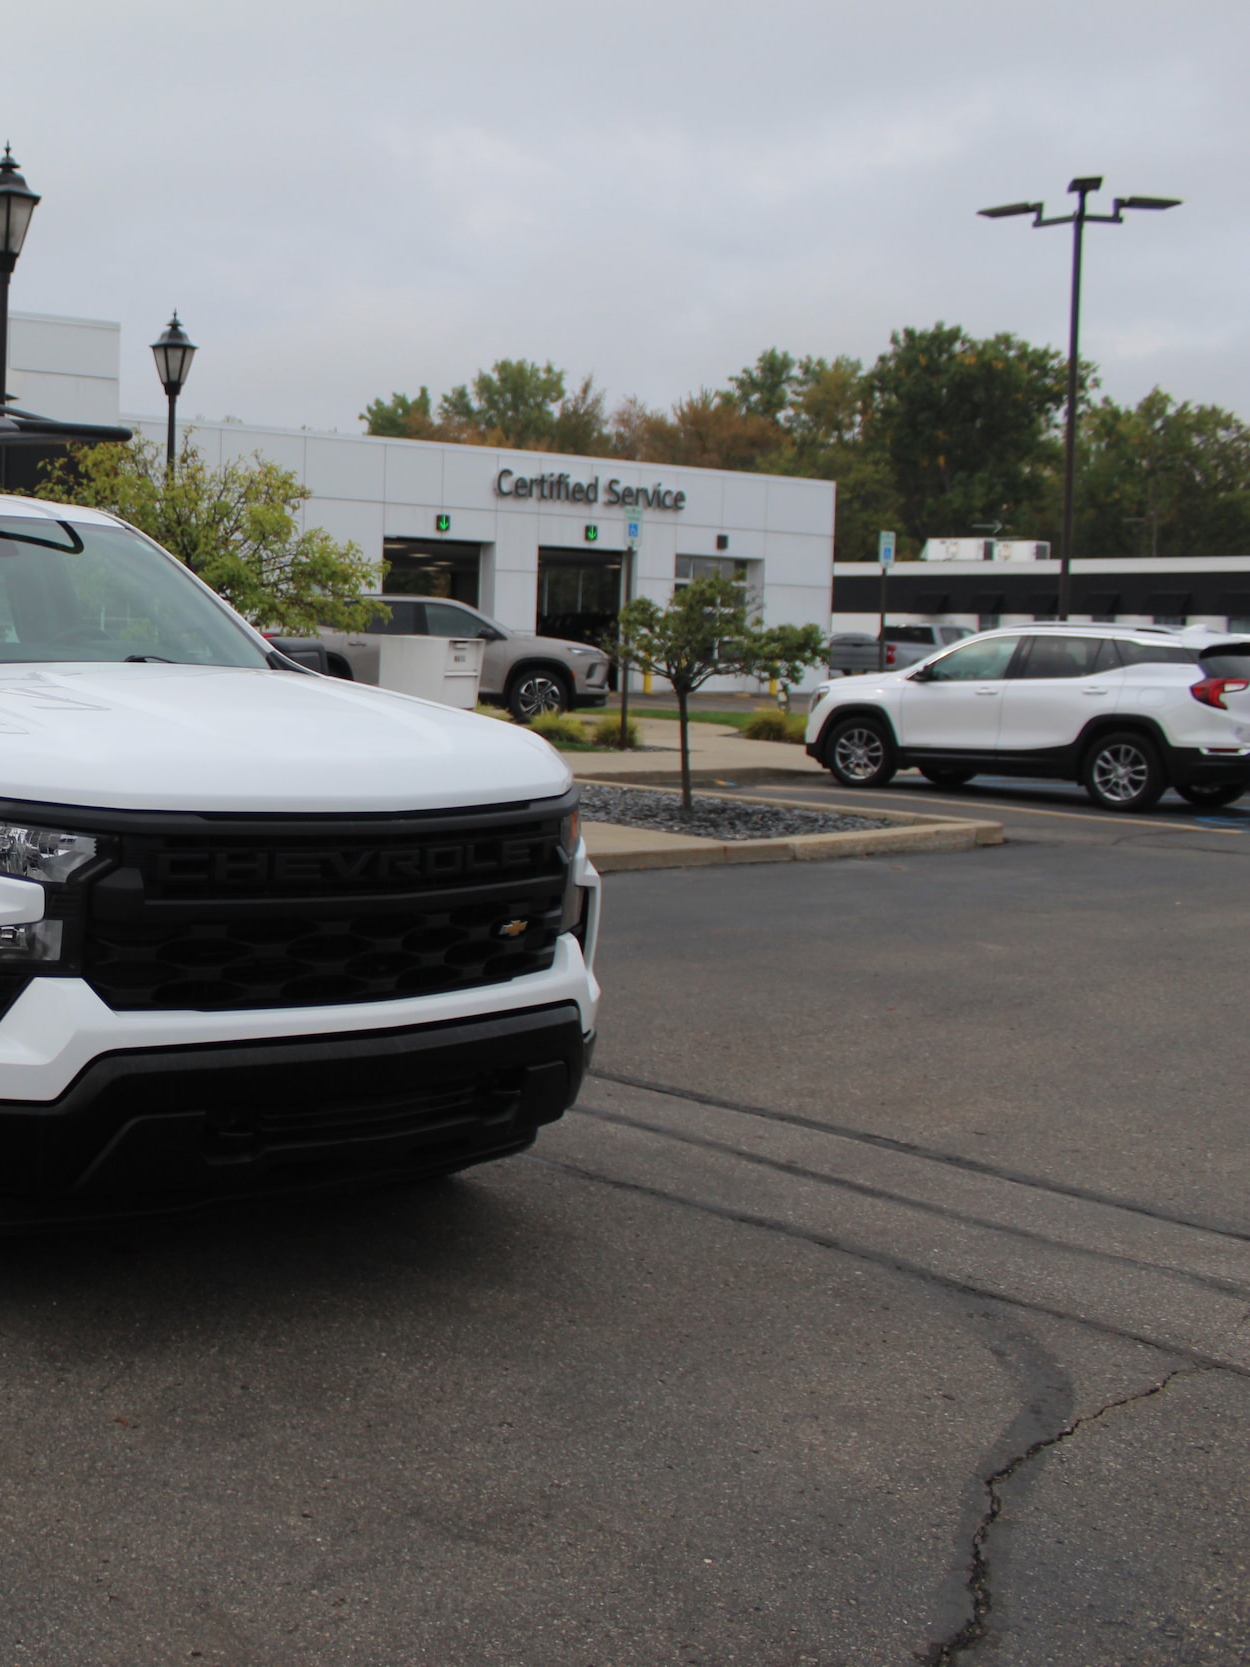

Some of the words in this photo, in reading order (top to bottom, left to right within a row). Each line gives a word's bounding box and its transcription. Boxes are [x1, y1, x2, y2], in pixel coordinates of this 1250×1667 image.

[496, 468, 599, 503] Certified
[605, 478, 686, 511] Service
[155, 836, 559, 884] CHEVROLET
